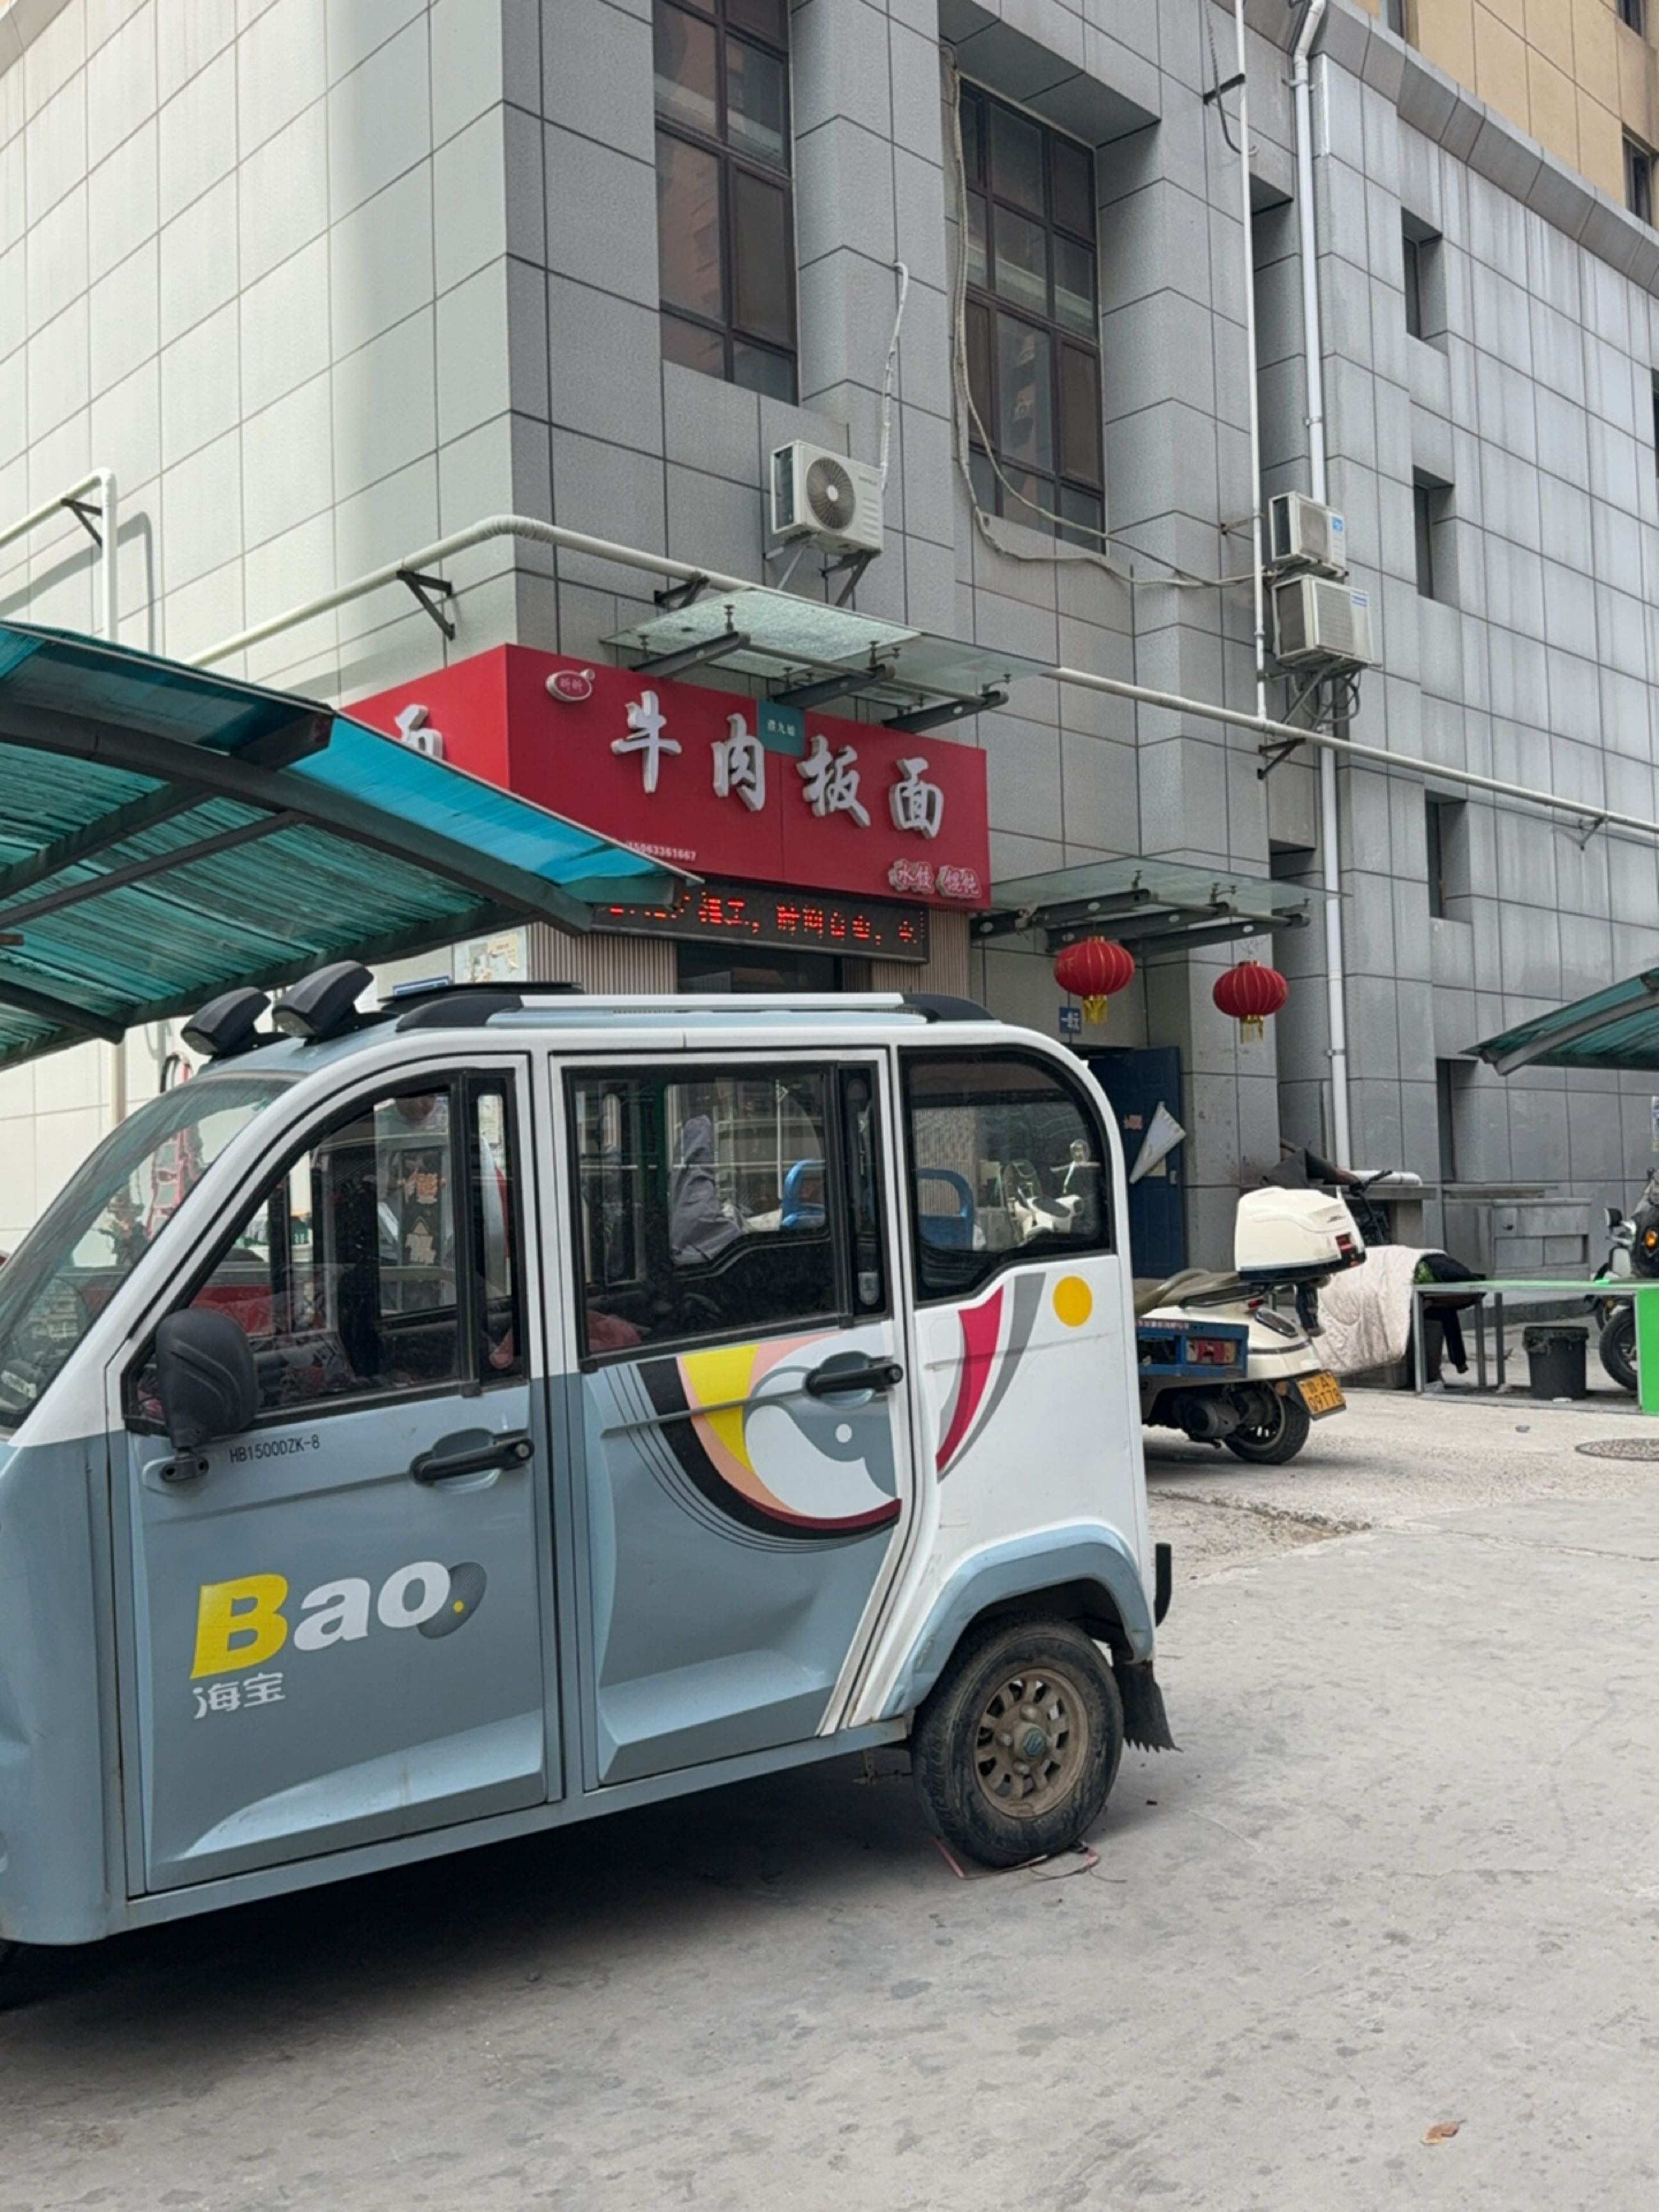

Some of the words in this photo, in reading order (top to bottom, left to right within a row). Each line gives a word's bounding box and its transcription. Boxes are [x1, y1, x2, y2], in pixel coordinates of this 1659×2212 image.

[611, 690, 945, 839] 牛肉板面
[229, 1434, 321, 1463] HB1500DZK-8
[189, 1560, 452, 1680] Bao
[193, 1672, 286, 1720] 海宝
